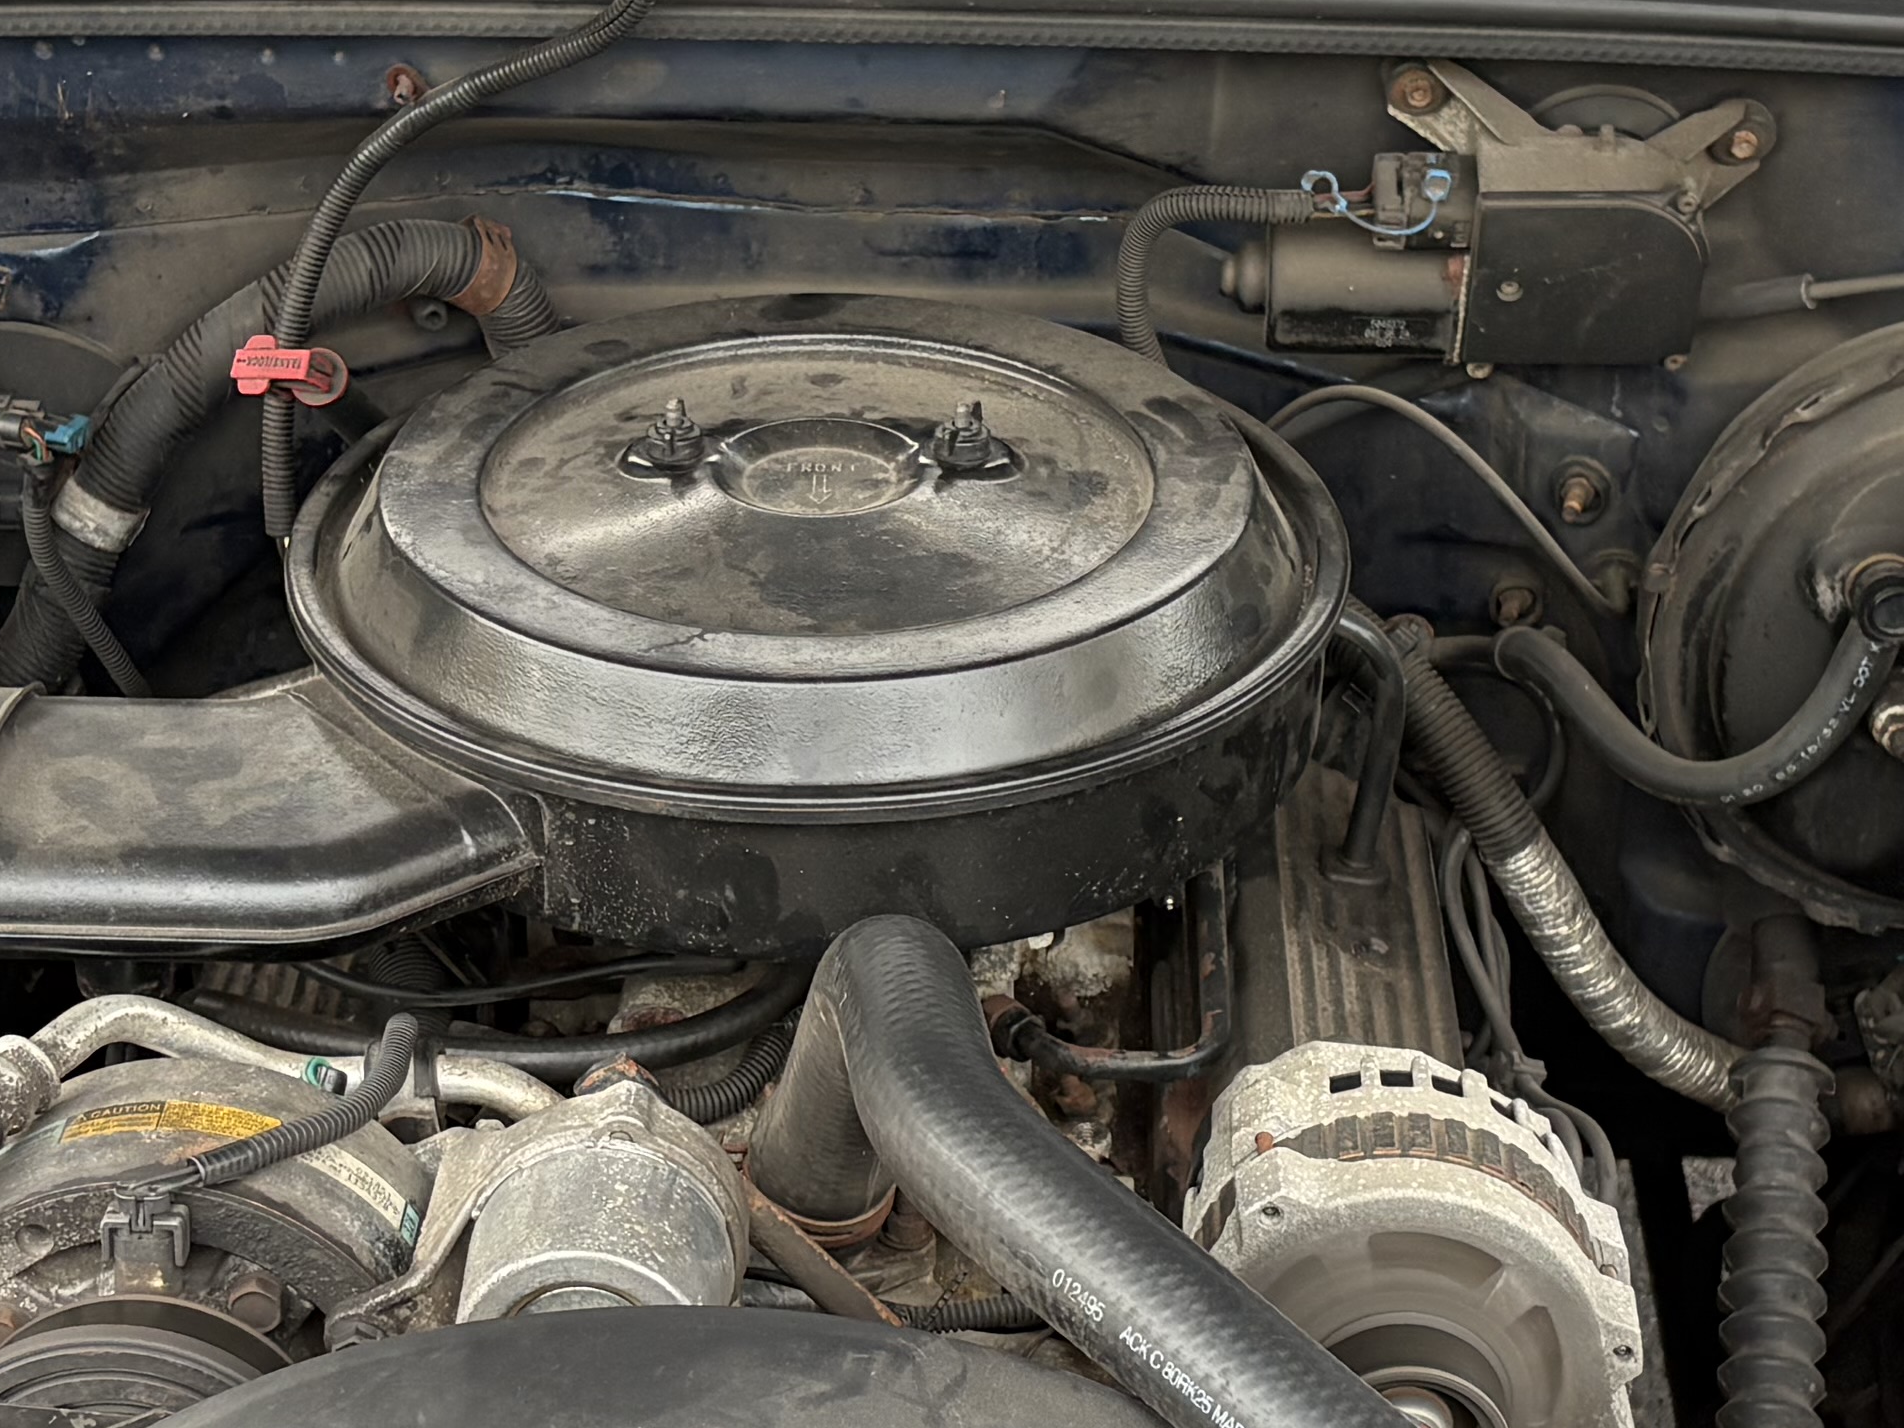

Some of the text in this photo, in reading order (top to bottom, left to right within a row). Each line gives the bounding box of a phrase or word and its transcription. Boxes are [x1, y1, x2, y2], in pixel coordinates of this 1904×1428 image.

[89, 1103, 161, 1119] CAUTION
[1052, 1269, 1105, 1322] 012495
[1119, 1327, 1151, 1360] ACK
[1150, 1350, 1164, 1369] C
